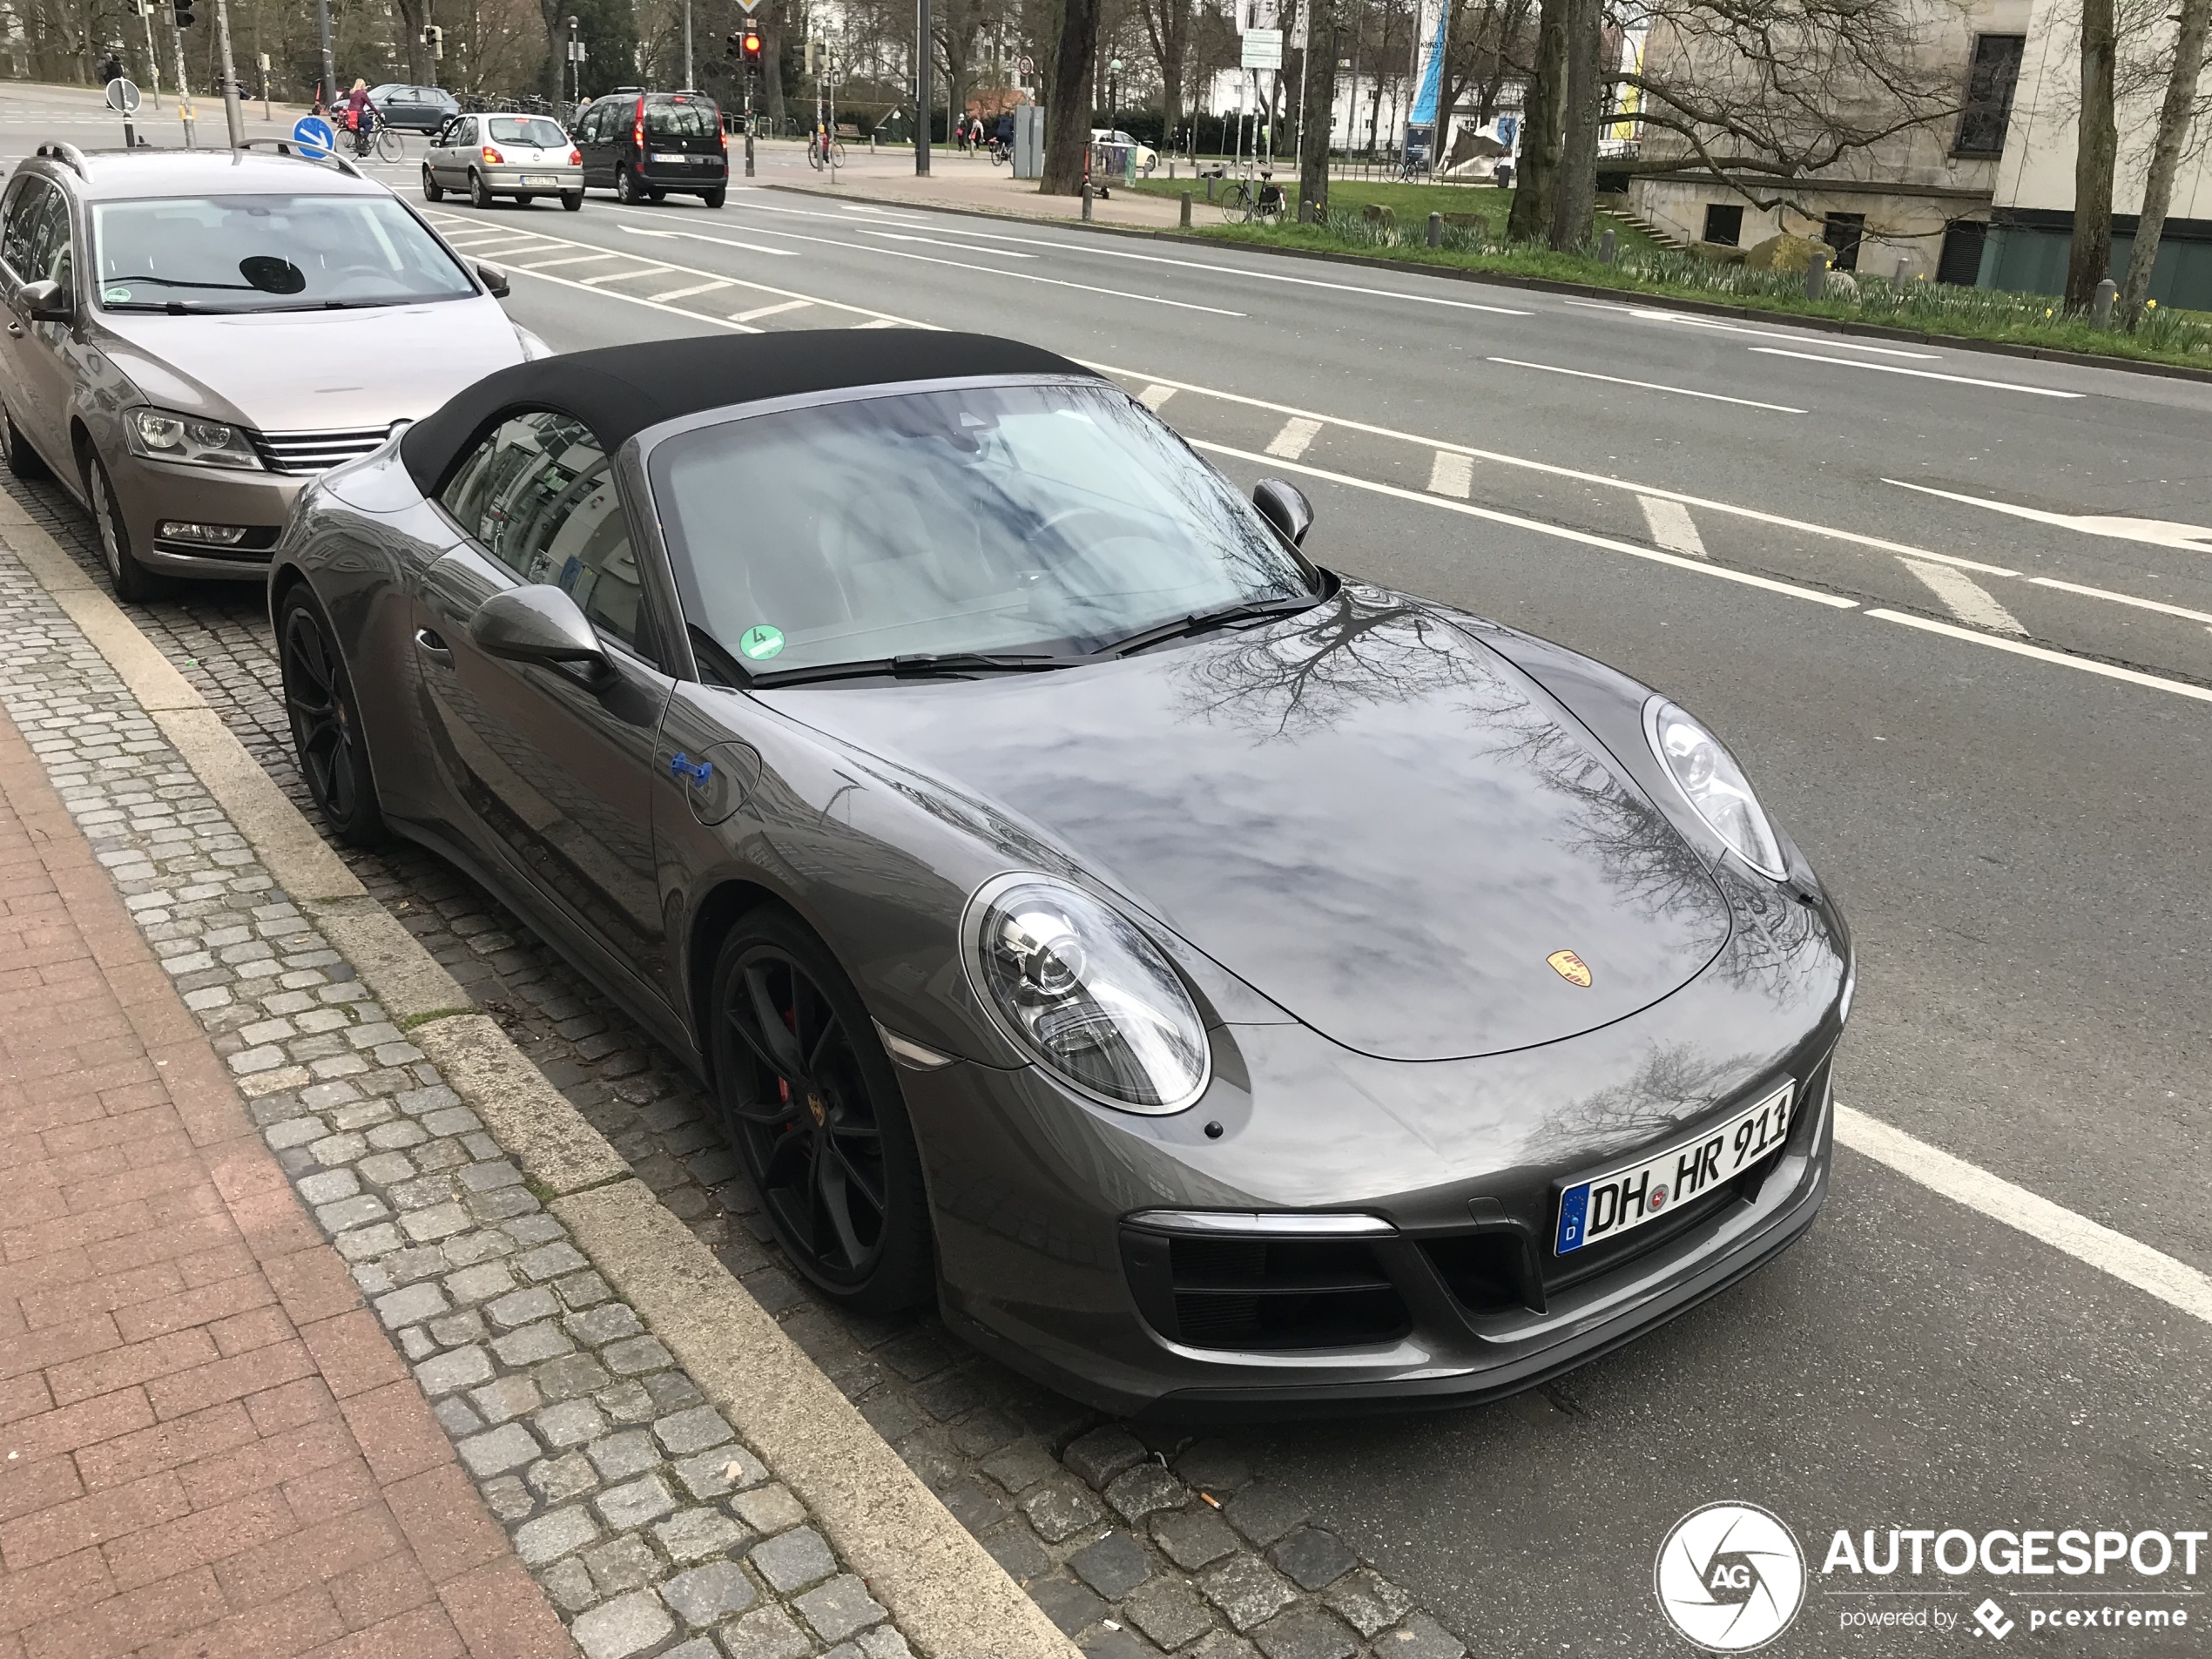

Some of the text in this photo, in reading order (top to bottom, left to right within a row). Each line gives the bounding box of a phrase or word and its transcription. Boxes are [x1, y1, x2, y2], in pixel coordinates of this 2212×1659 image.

[1022, 62, 1029, 71] 30
[752, 628, 766, 643] 4
[1588, 1094, 1789, 1237] DH HR 911
[1565, 1225, 1575, 1241] D
